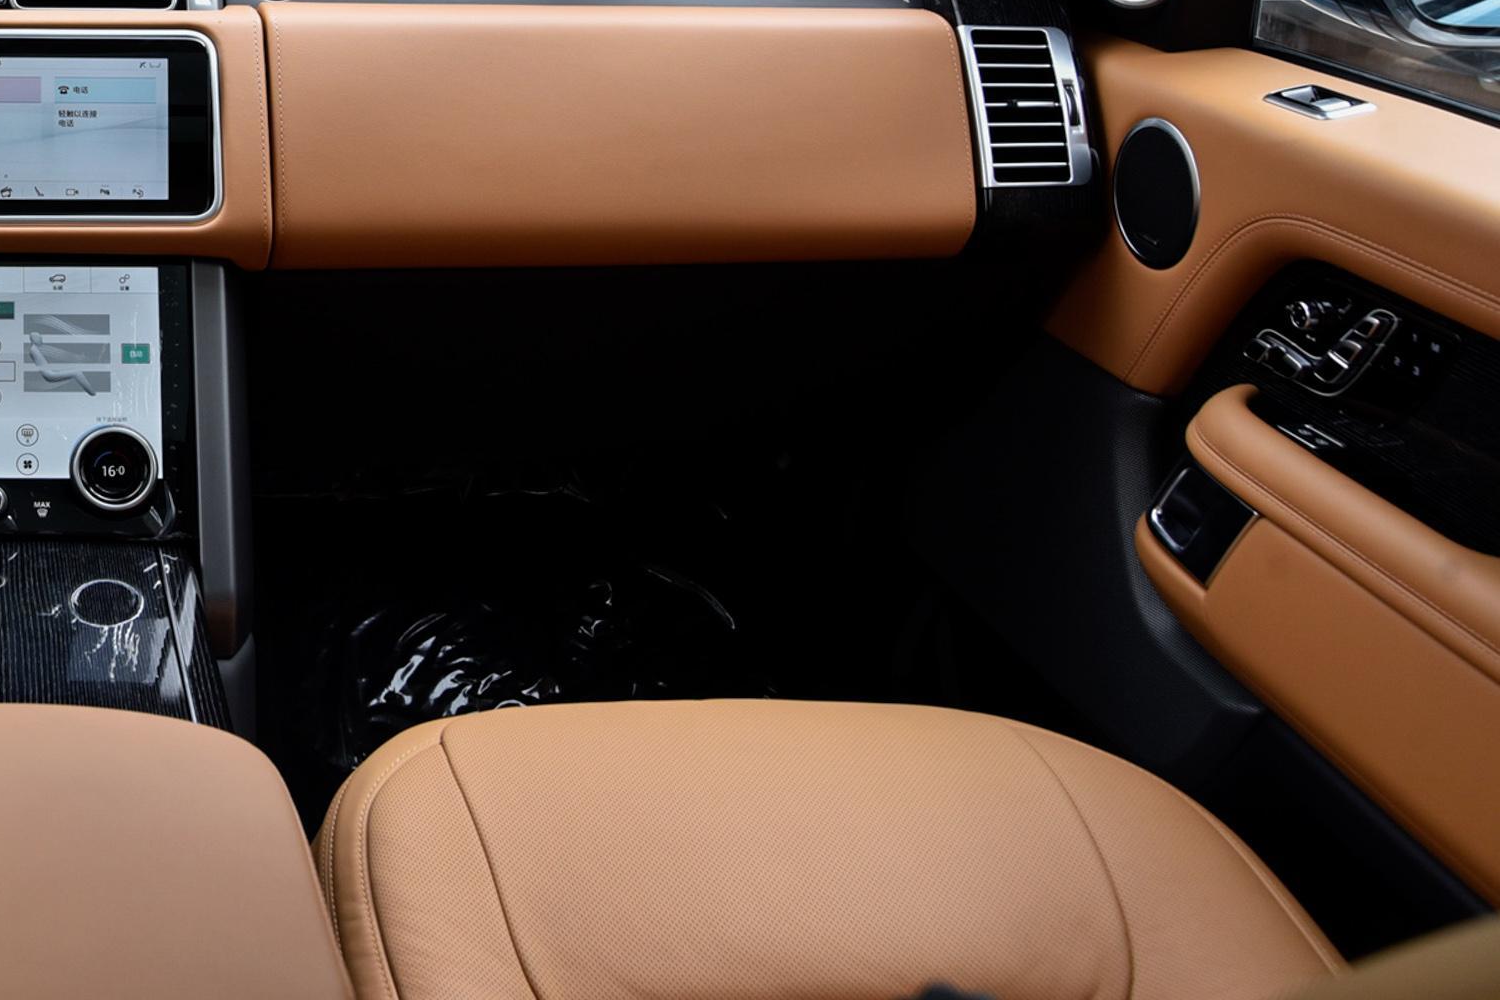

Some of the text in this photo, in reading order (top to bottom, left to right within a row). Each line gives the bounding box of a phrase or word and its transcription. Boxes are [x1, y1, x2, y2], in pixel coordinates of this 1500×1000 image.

[72, 86, 89, 94] 电话
[58, 109, 98, 118] 轻触以连接
[57, 119, 74, 128] 电话
